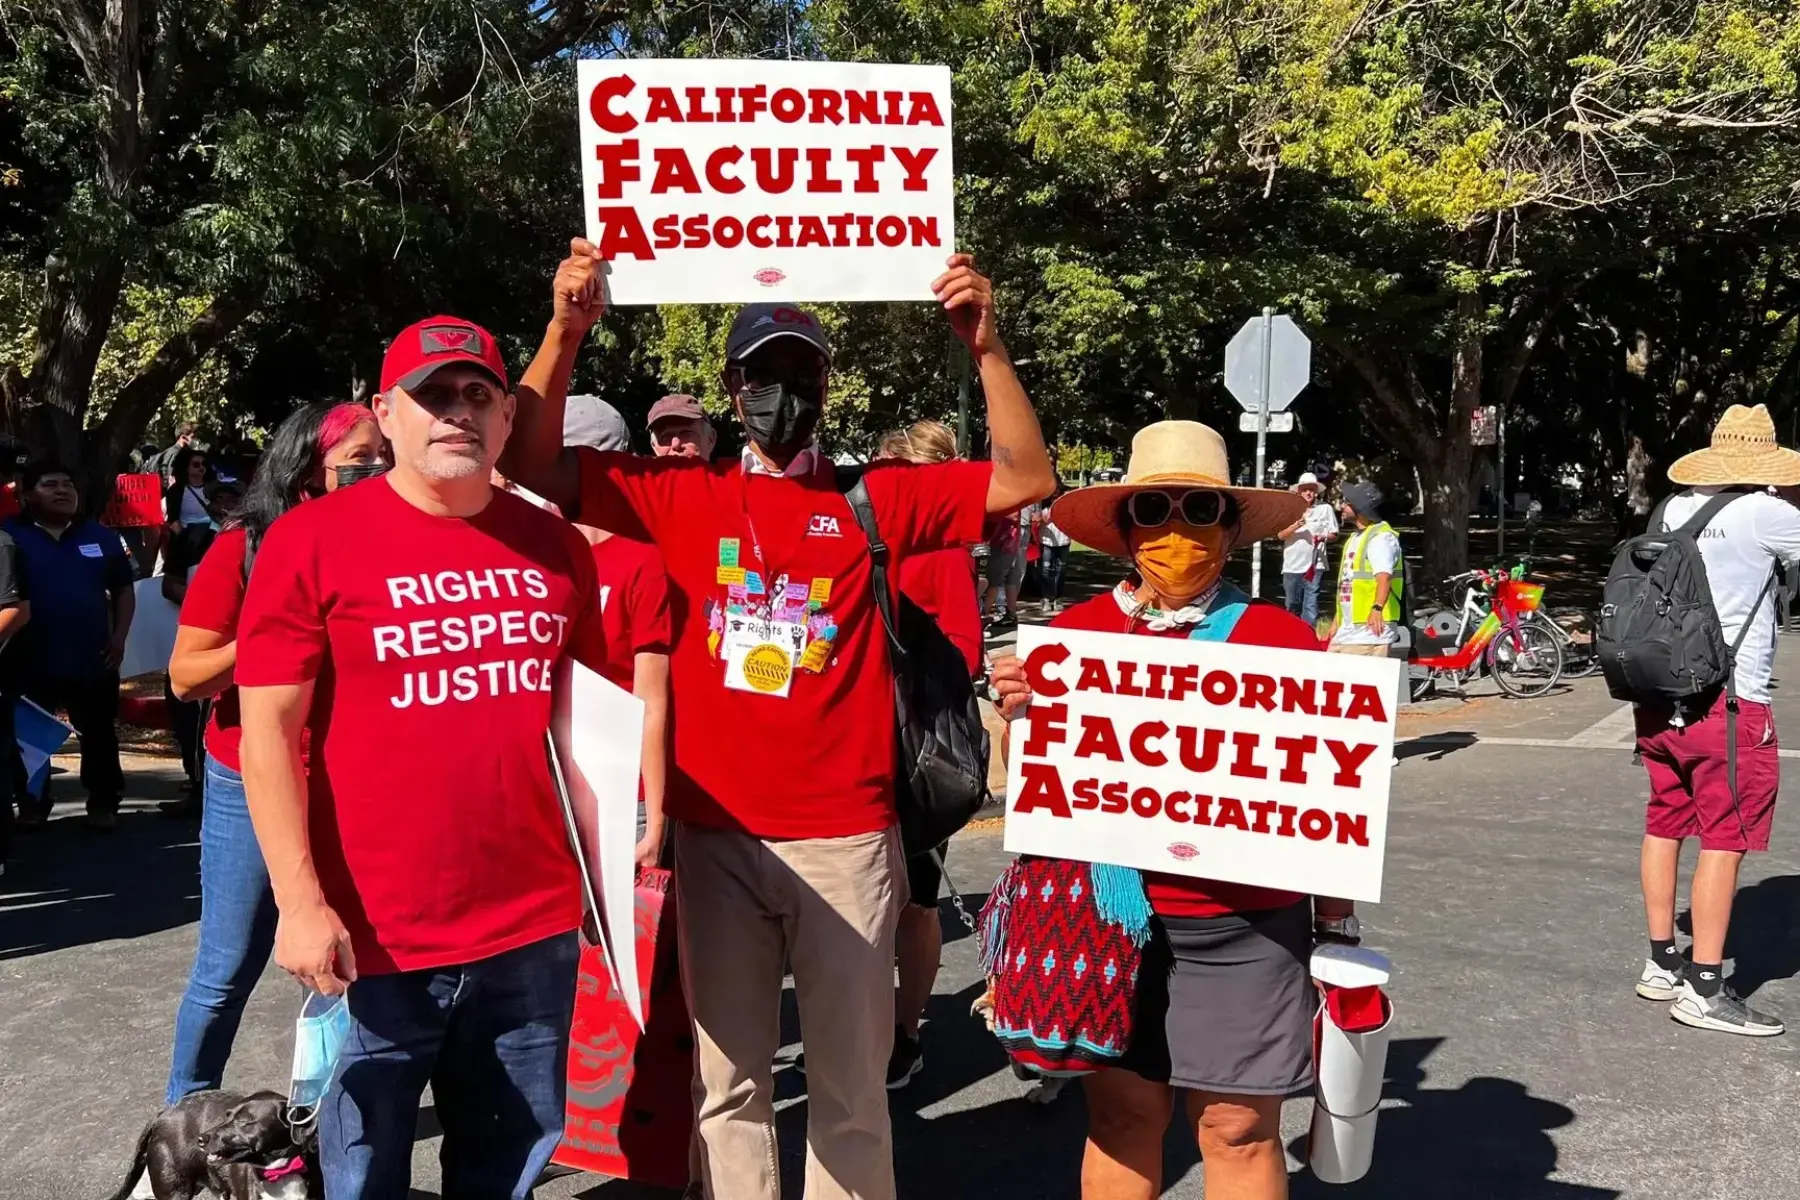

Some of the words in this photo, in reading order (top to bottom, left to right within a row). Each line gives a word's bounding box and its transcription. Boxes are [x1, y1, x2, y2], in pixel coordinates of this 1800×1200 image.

[590, 73, 945, 134] CALIFORNIA
[596, 138, 939, 199] FACULTY
[598, 206, 941, 261] ASSOCIATION
[809, 515, 840, 533] CFA
[1700, 528, 1726, 539] DIA
[386, 568, 549, 609] RIGHTS
[373, 610, 568, 662] RESPECT
[747, 657, 788, 672] CAUTION
[1025, 642, 1388, 723] CALIFORNIA
[1023, 702, 1378, 788] FACULTY
[1013, 762, 1369, 847] ASSOCIATION
